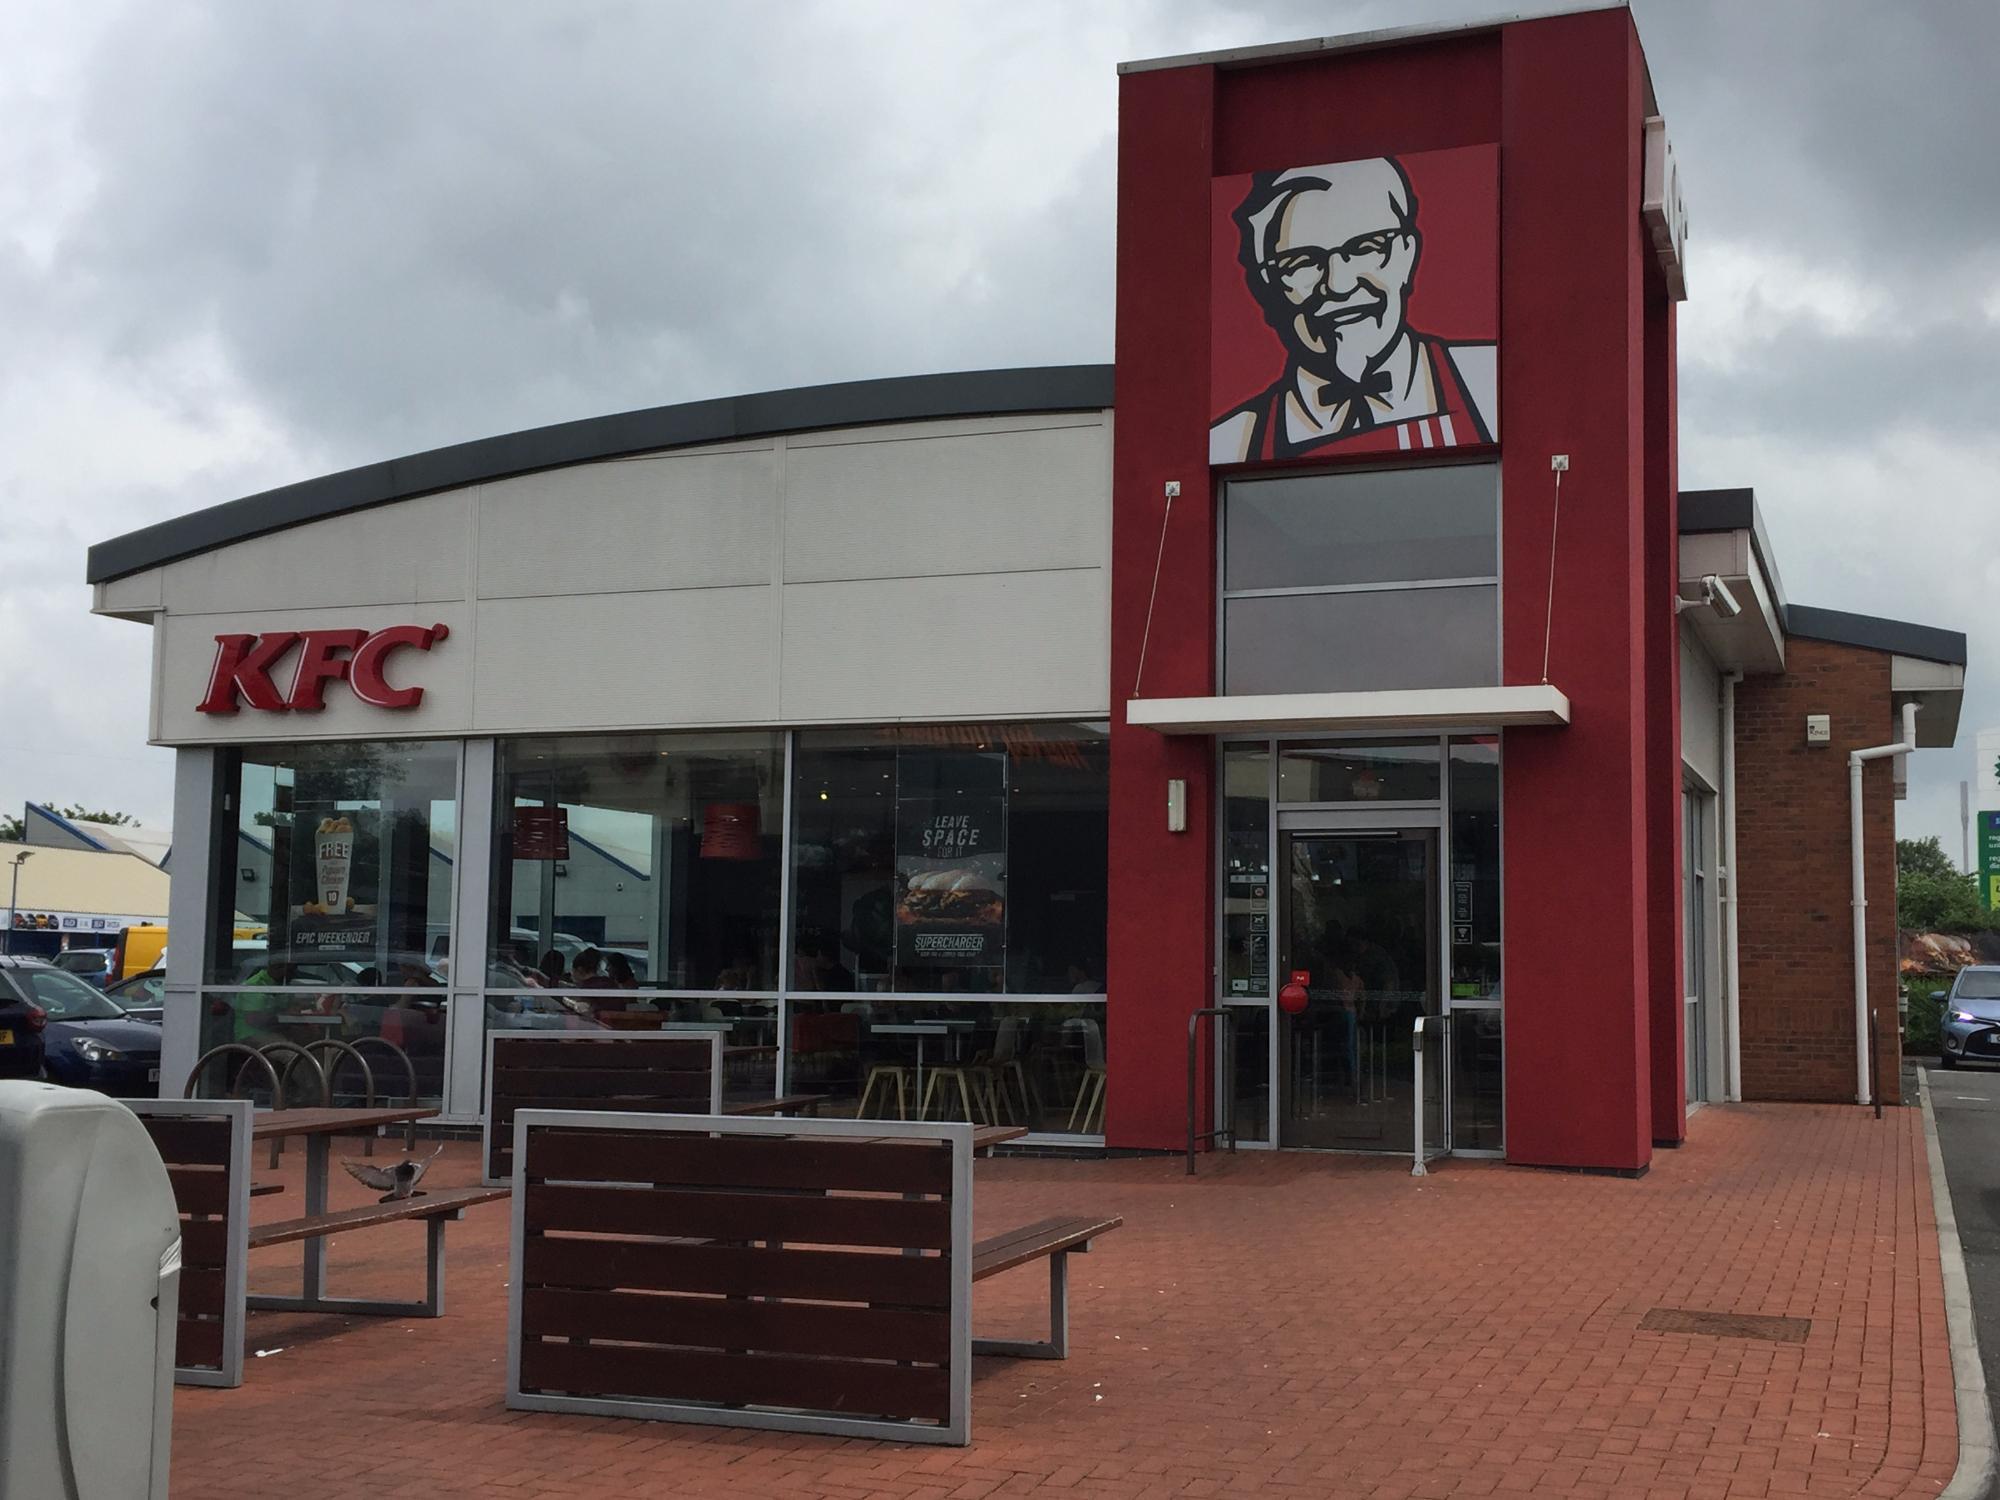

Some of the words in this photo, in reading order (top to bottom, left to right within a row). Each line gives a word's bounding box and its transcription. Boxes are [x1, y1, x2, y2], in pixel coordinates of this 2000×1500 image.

[196, 623, 449, 714] KFC
[935, 815, 970, 828] LEAVE
[922, 829, 980, 846] SPACE
[319, 841, 349, 859] FREE
[955, 846, 964, 857] IT
[327, 892, 337, 901] 10
[296, 932, 316, 944] EPIC
[317, 931, 371, 944] WEEKENDER
[915, 936, 984, 949] SUPERCHARGER
